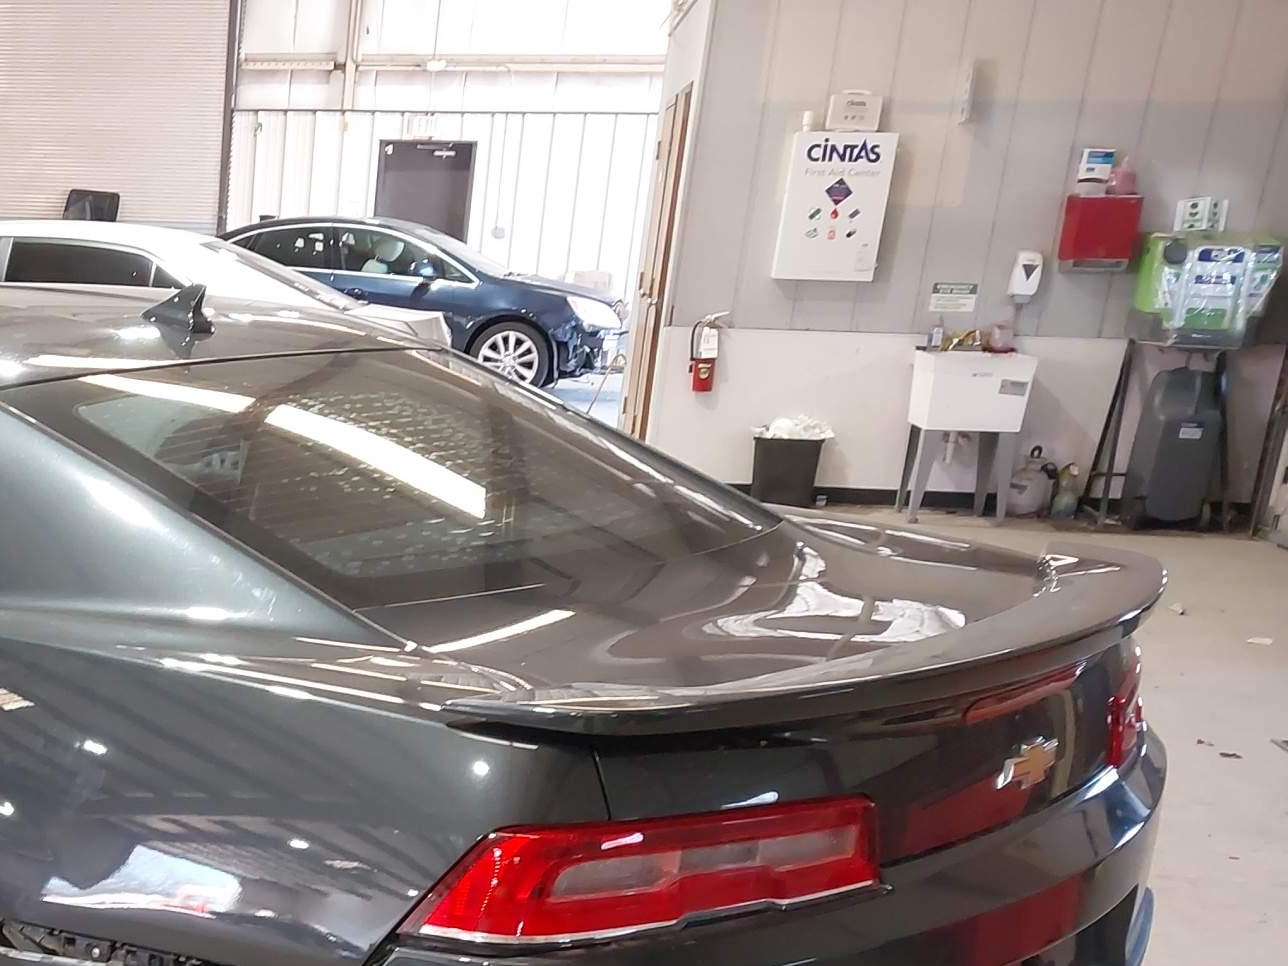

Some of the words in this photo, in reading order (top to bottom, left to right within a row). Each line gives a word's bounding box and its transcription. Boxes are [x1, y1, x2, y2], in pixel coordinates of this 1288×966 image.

[804, 167, 825, 177] First
[828, 167, 845, 177] Aid
[848, 167, 881, 177] Center
